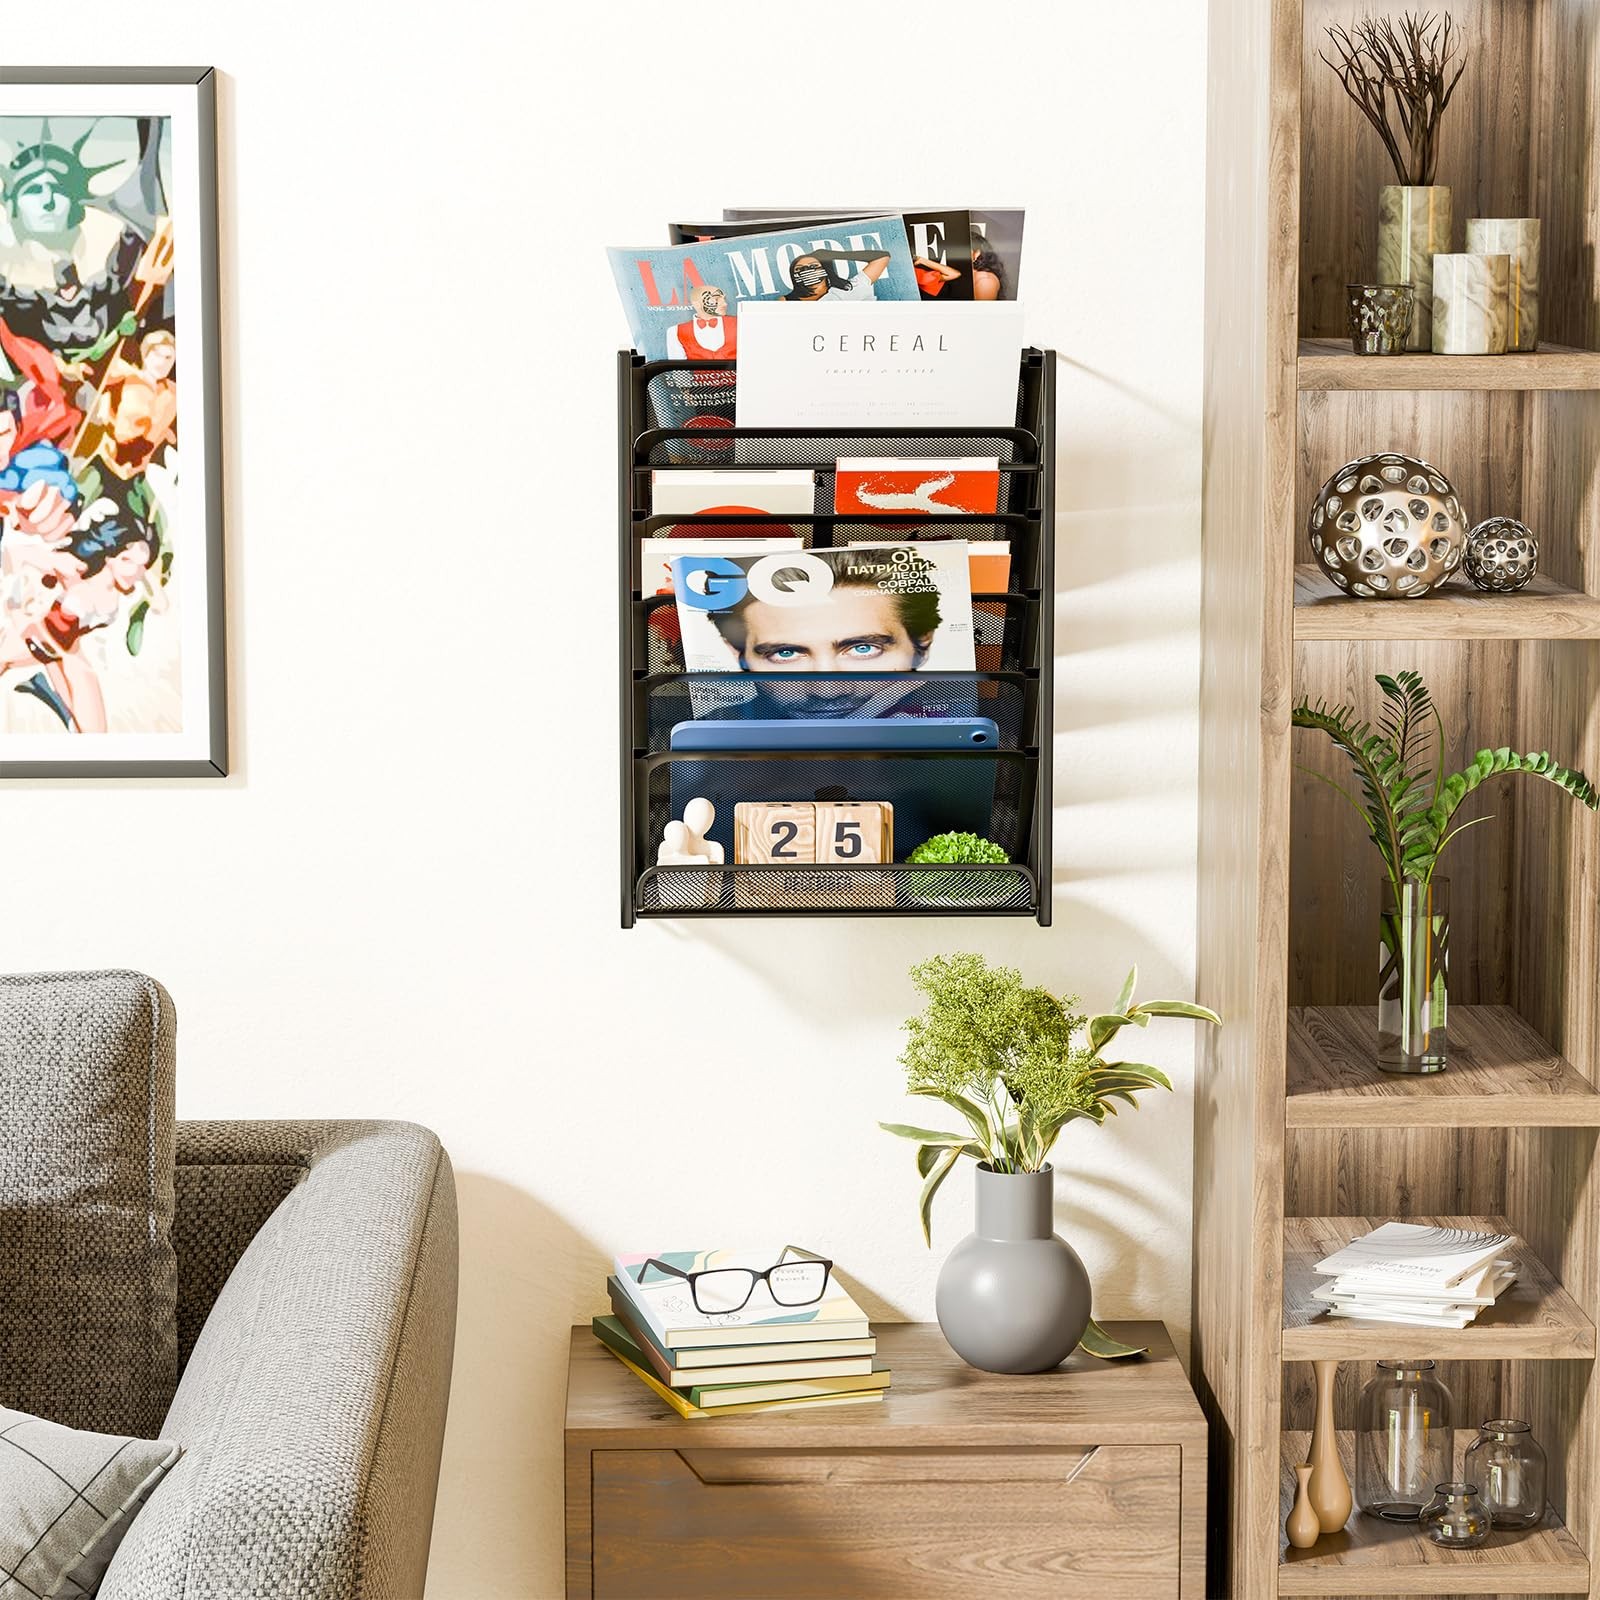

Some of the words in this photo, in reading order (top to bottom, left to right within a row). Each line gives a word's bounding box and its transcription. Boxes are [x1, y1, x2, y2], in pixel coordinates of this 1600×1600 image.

[635, 256, 705, 307] LA
[812, 334, 949, 352] CEREAL
[671, 553, 837, 610] GQ
[771, 821, 798, 857] 2
[835, 822, 862, 858] 5
